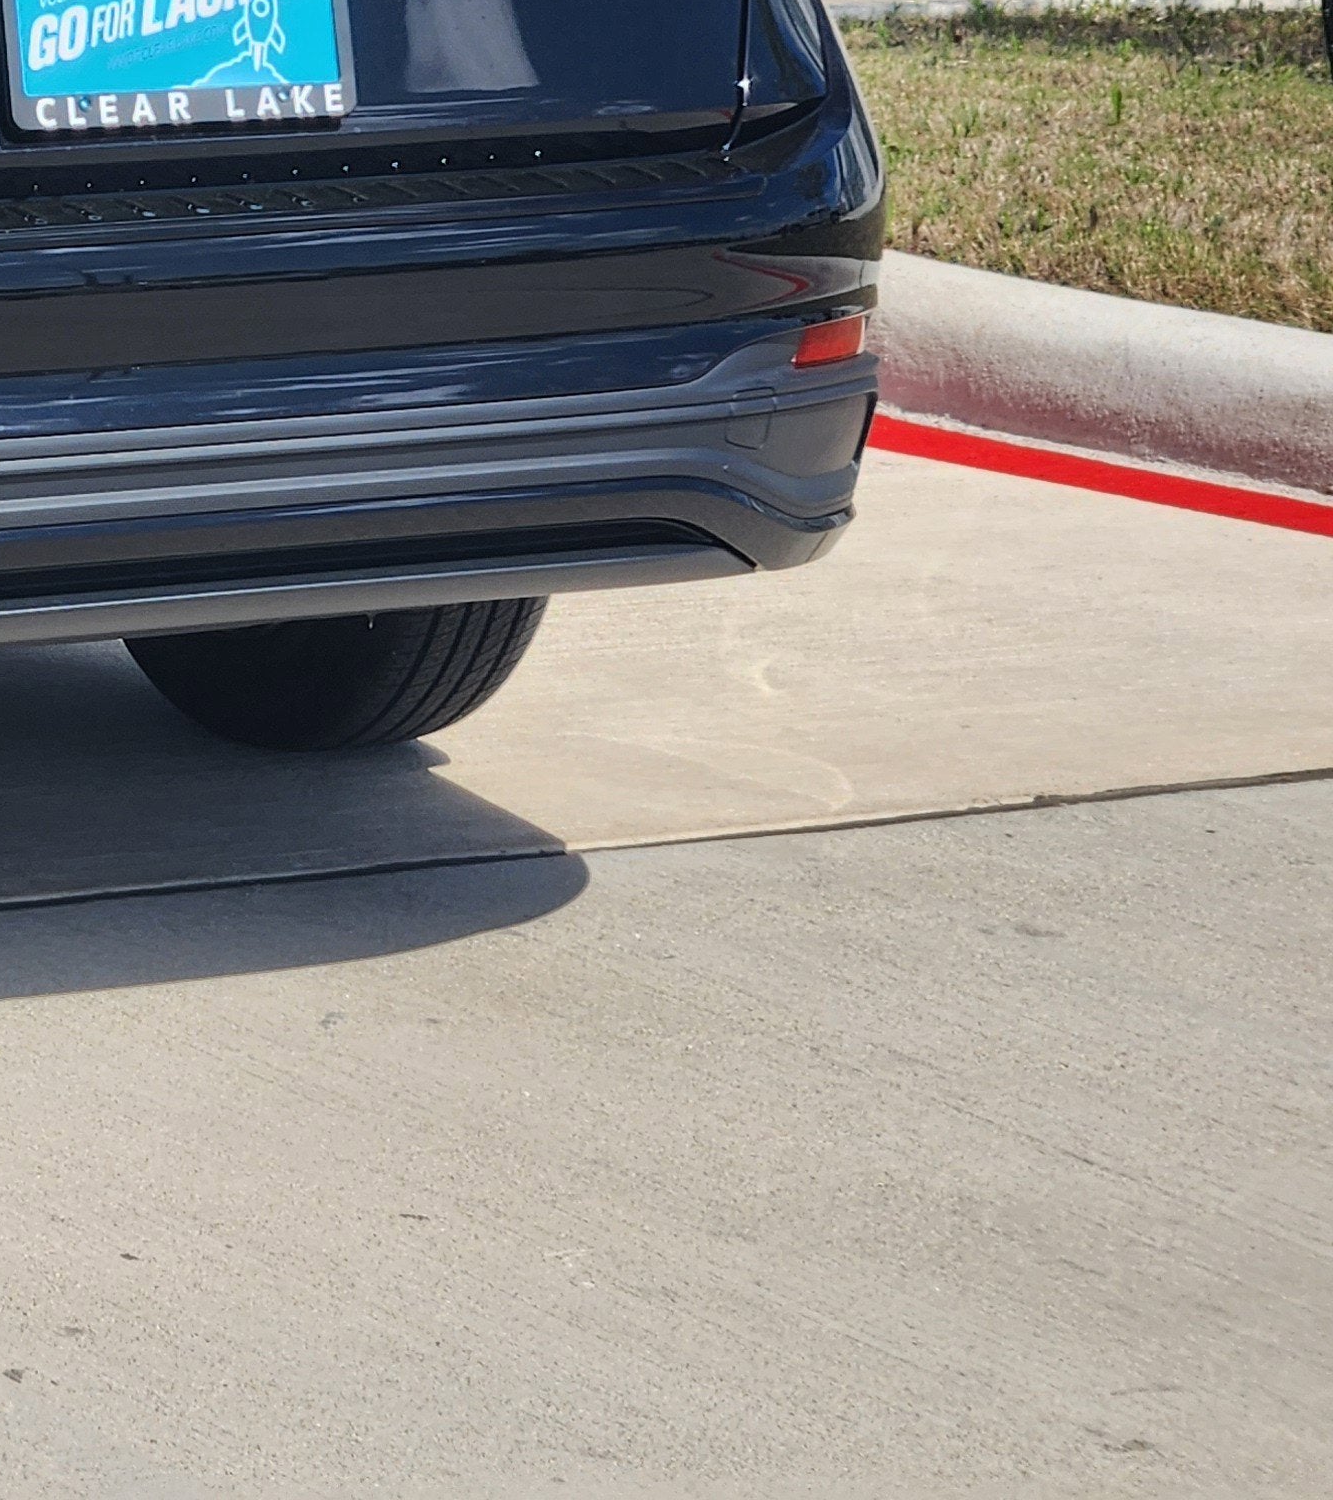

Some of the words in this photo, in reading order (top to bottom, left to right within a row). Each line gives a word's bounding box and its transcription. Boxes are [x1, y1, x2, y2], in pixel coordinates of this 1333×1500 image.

[28, 5, 88, 71] GO
[35, 92, 191, 130] CLEAR
[224, 83, 345, 120] LAKE
